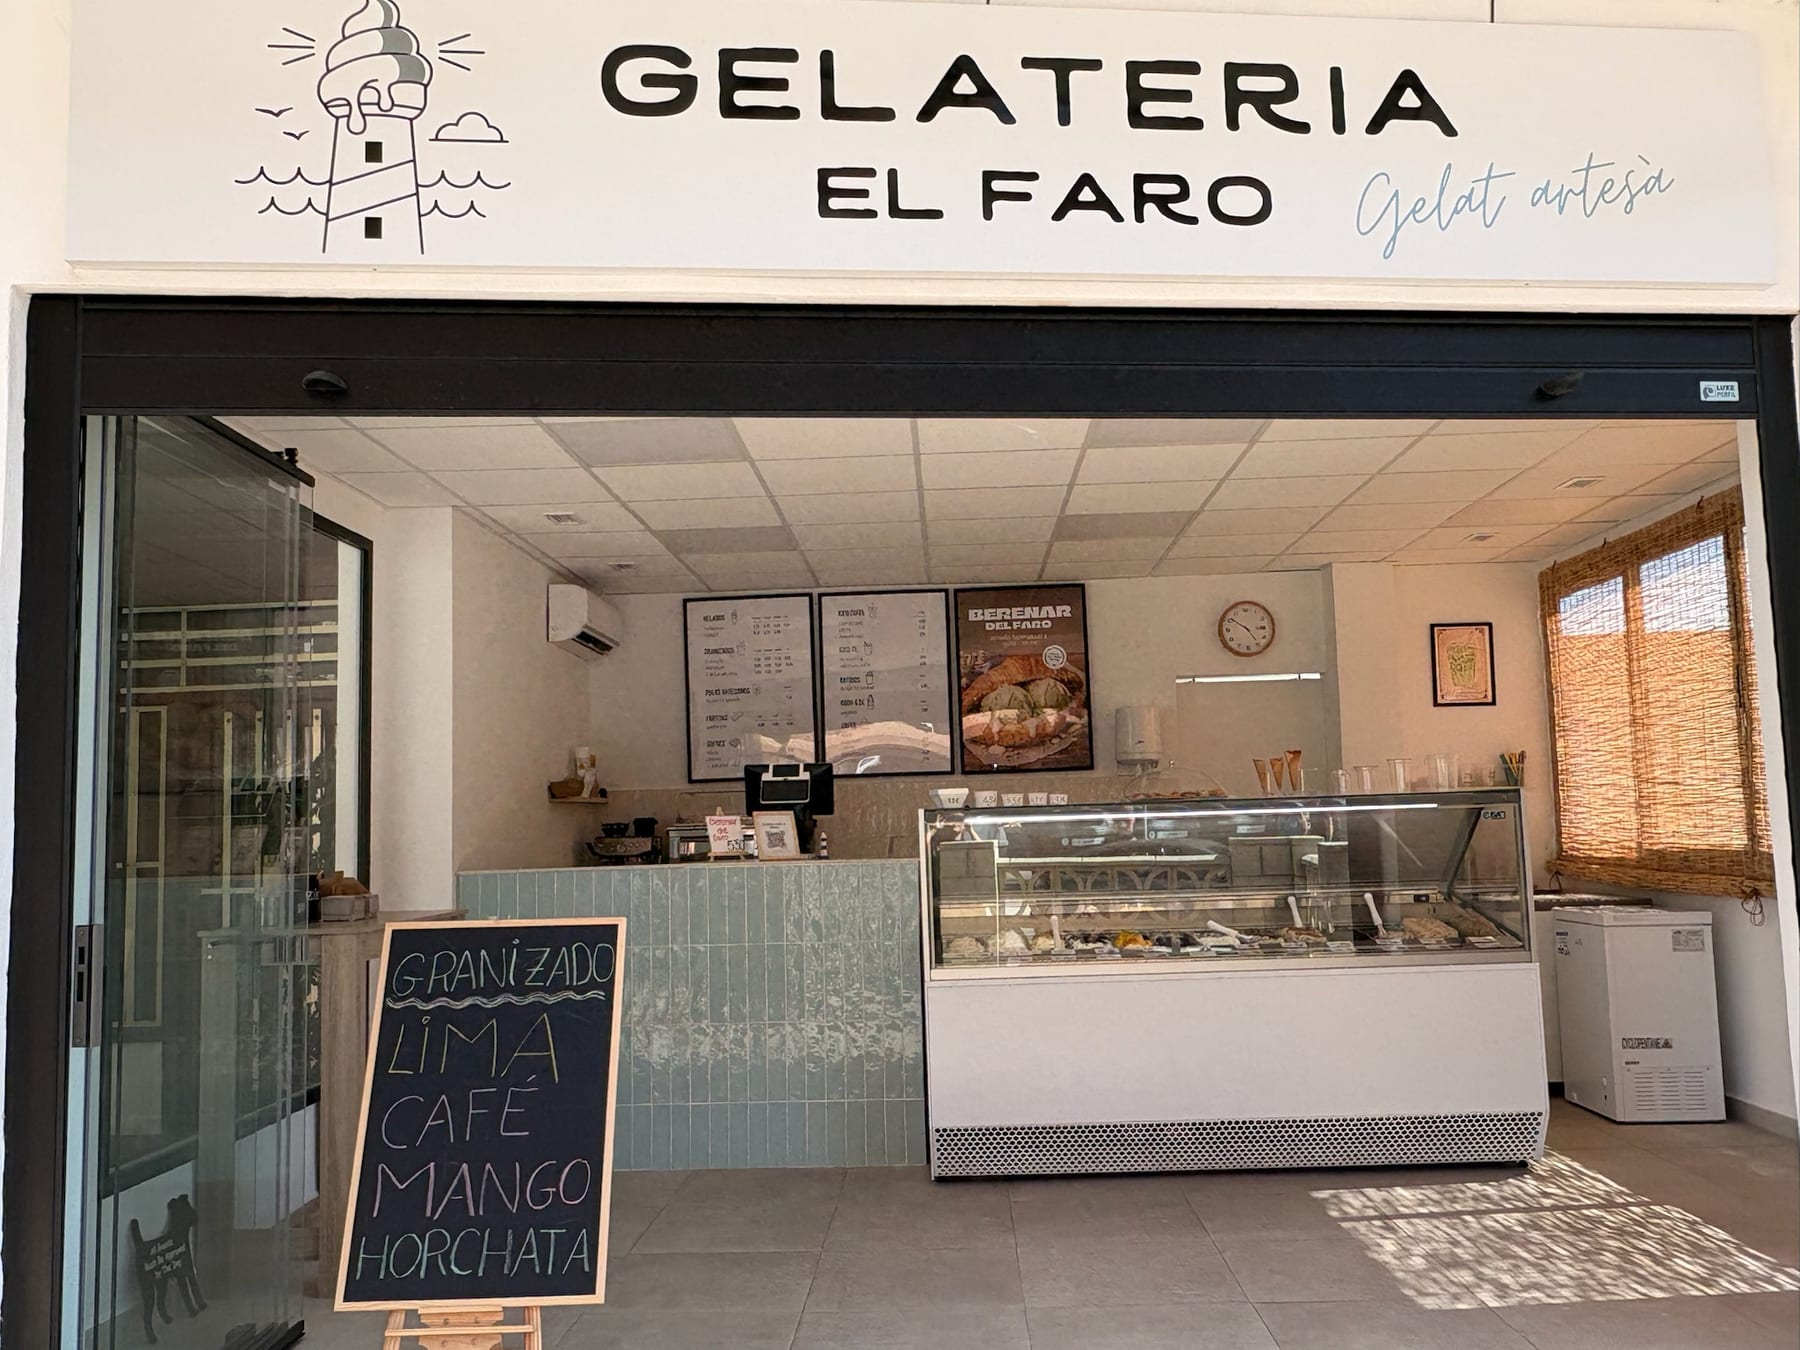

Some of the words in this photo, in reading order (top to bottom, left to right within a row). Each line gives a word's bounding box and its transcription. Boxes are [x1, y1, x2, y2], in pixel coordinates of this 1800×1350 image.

[601, 44, 1459, 138] GELATERIA
[817, 166, 944, 220] EL
[981, 170, 1273, 226] FARO
[1355, 162, 1517, 260] Gelat
[1530, 151, 1675, 218] artesà
[968, 605, 1072, 622] BERENAR
[985, 622, 1012, 631] DEL
[1012, 620, 1052, 630] FARO
[392, 938, 615, 998] GRANIZADO
[381, 1074, 540, 1149] CAFÉ
[373, 1159, 591, 1220] MANGO
[356, 1229, 590, 1280] HORCHATA
